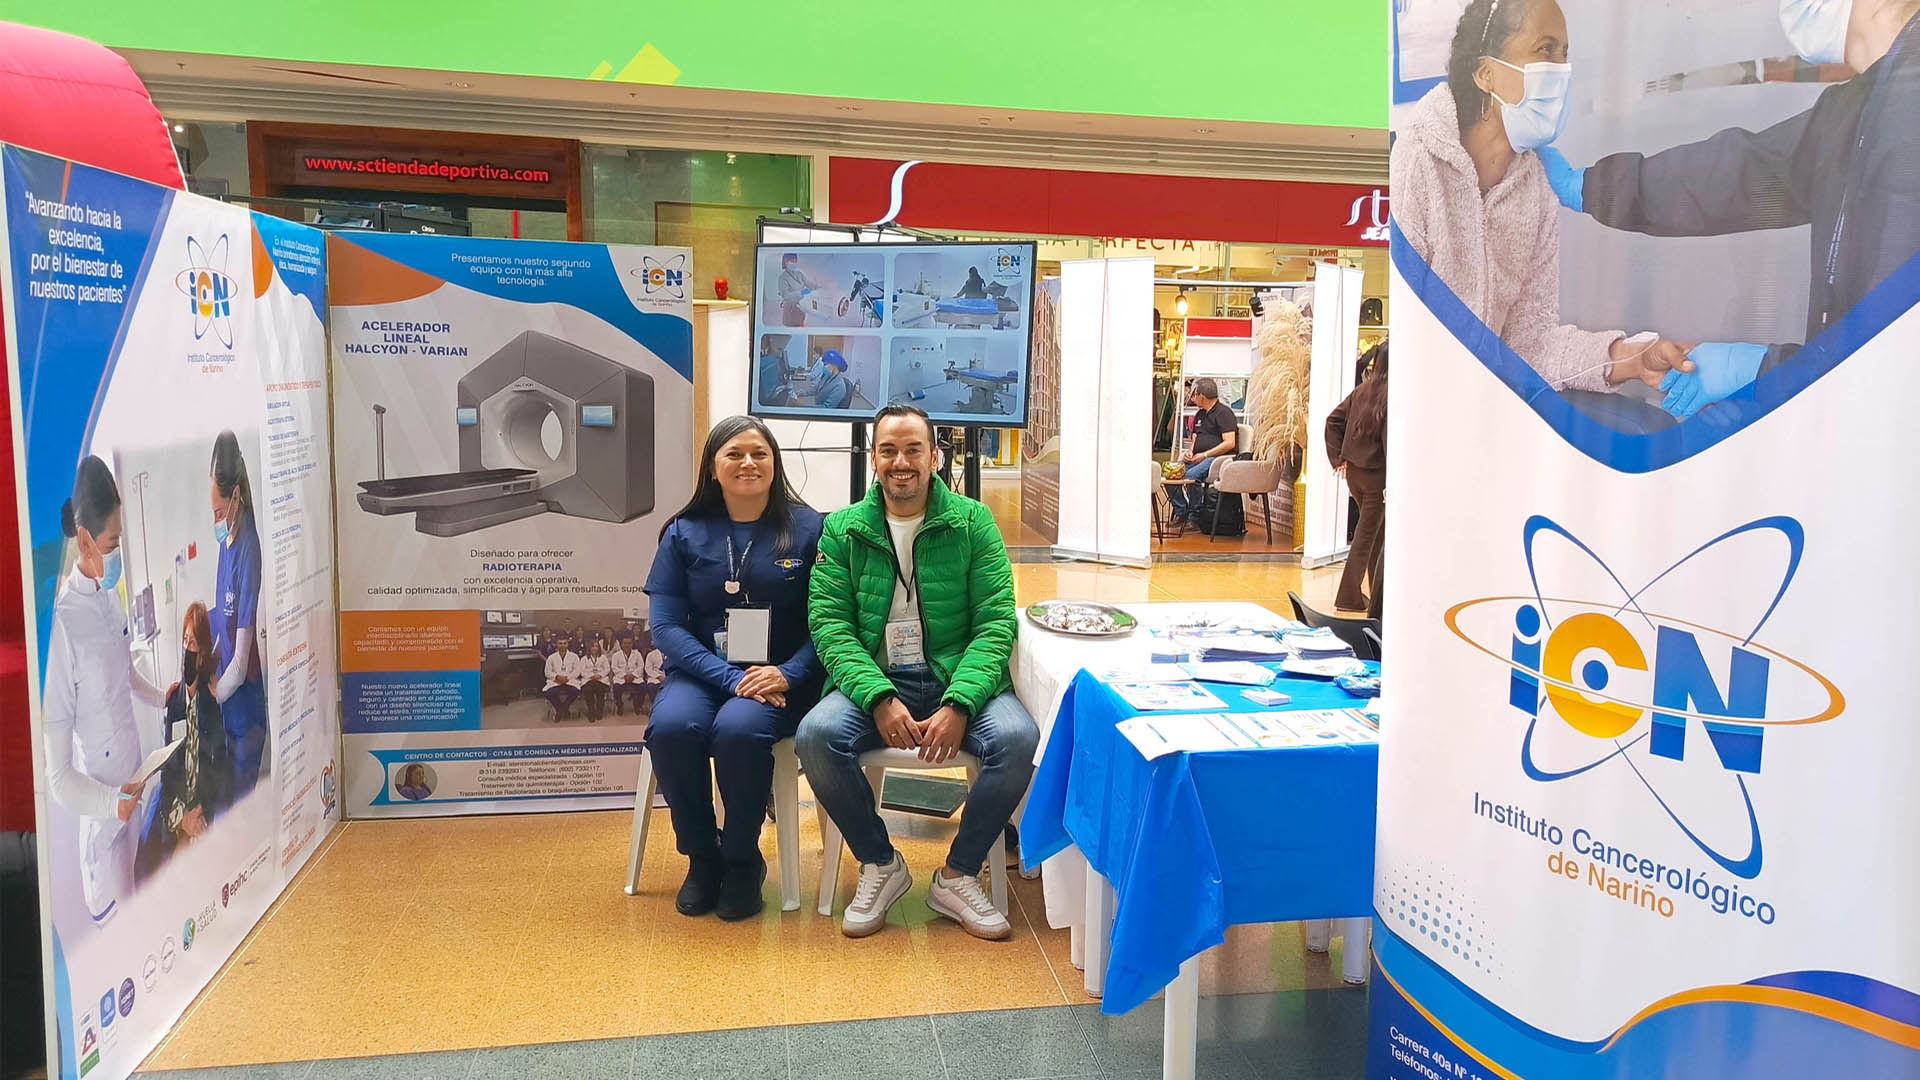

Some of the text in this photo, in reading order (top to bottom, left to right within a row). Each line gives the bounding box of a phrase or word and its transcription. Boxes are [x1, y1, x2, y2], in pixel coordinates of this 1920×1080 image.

[305, 158, 550, 183] www.sctiendadeportiva.com
[25, 190, 122, 230] “Avanzando hacia la
[49, 228, 104, 255] excelencia,
[31, 252, 123, 279] por el bienestar de
[451, 253, 591, 269] Presentamos nuestro segundo
[470, 265, 502, 275] equipo
[524, 266, 533, 276] la
[536, 267, 554, 277] más
[557, 268, 573, 278] alta
[30, 280, 75, 300] nuestros
[361, 321, 450, 333] ACELERADOR
[384, 333, 430, 344] LINEAL
[345, 344, 408, 355] HALCYON
[420, 346, 468, 356] VARIAN
[470, 549, 573, 559] Diseñado para ofrecer
[483, 563, 562, 571] RADIOTERAPIA
[484, 576, 533, 584] excelencia
[368, 586, 402, 595] calidad
[405, 586, 460, 596] optimizada,
[464, 586, 519, 595] simplificada
[529, 585, 546, 596] ágil
[548, 587, 569, 595] para
[572, 585, 619, 593] resultados
[359, 696, 381, 704] seguro
[561, 747, 587, 755] MÉDICA
[588, 746, 638, 754] ESPECIALIZADA
[1474, 792, 1776, 926] Instituto Cancerológico
[1548, 852, 1675, 919] de Nariño
[1390, 1026, 1430, 1059] Carrera
[1432, 1051, 1452, 1073] 40a
